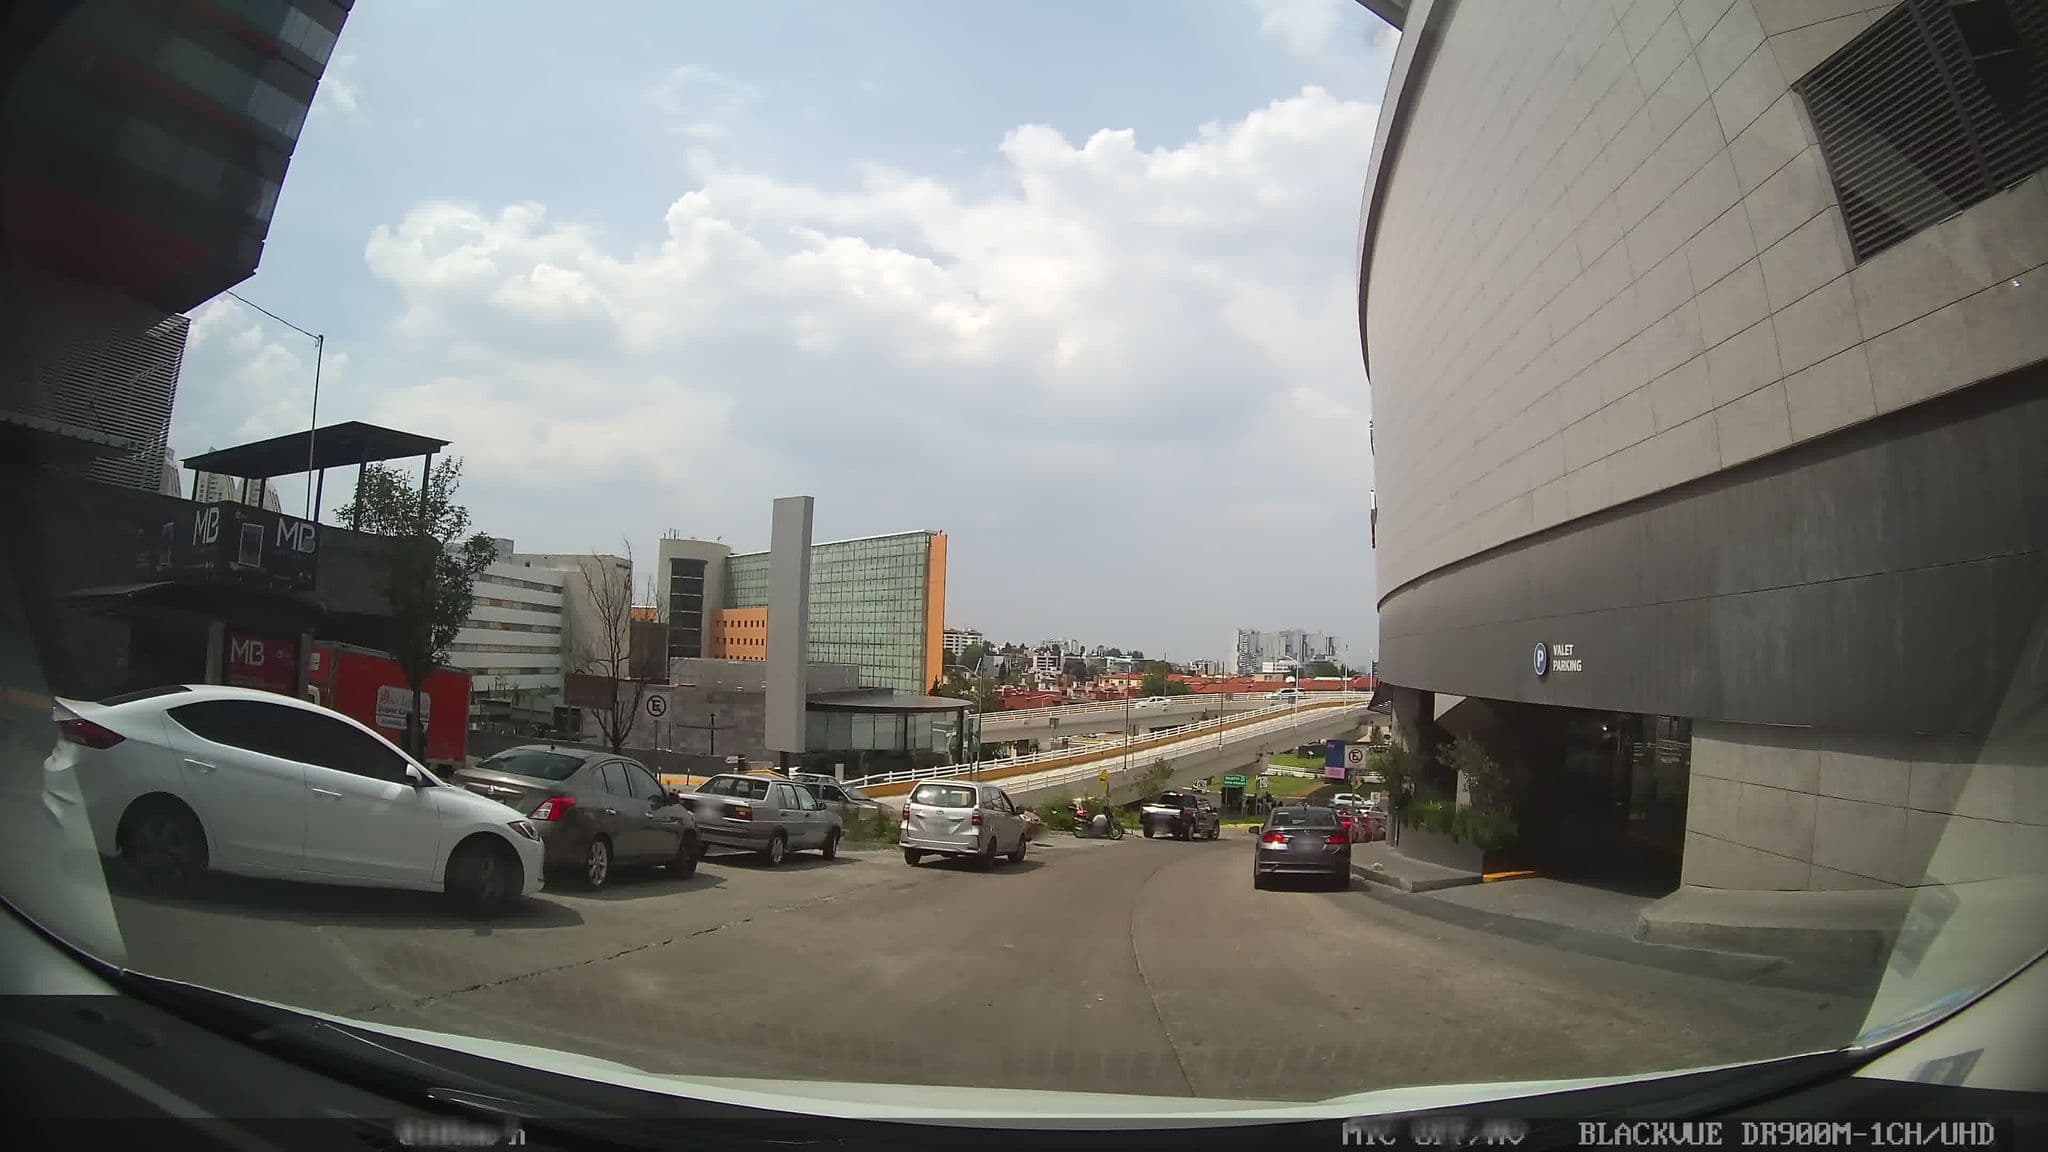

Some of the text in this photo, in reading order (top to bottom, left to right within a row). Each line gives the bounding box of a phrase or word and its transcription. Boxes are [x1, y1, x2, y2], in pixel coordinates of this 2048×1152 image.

[192, 507, 220, 546] MB
[275, 517, 316, 554] MB
[230, 637, 265, 666] MB
[1553, 644, 1574, 656] VALET
[1552, 659, 1582, 672] PARKING
